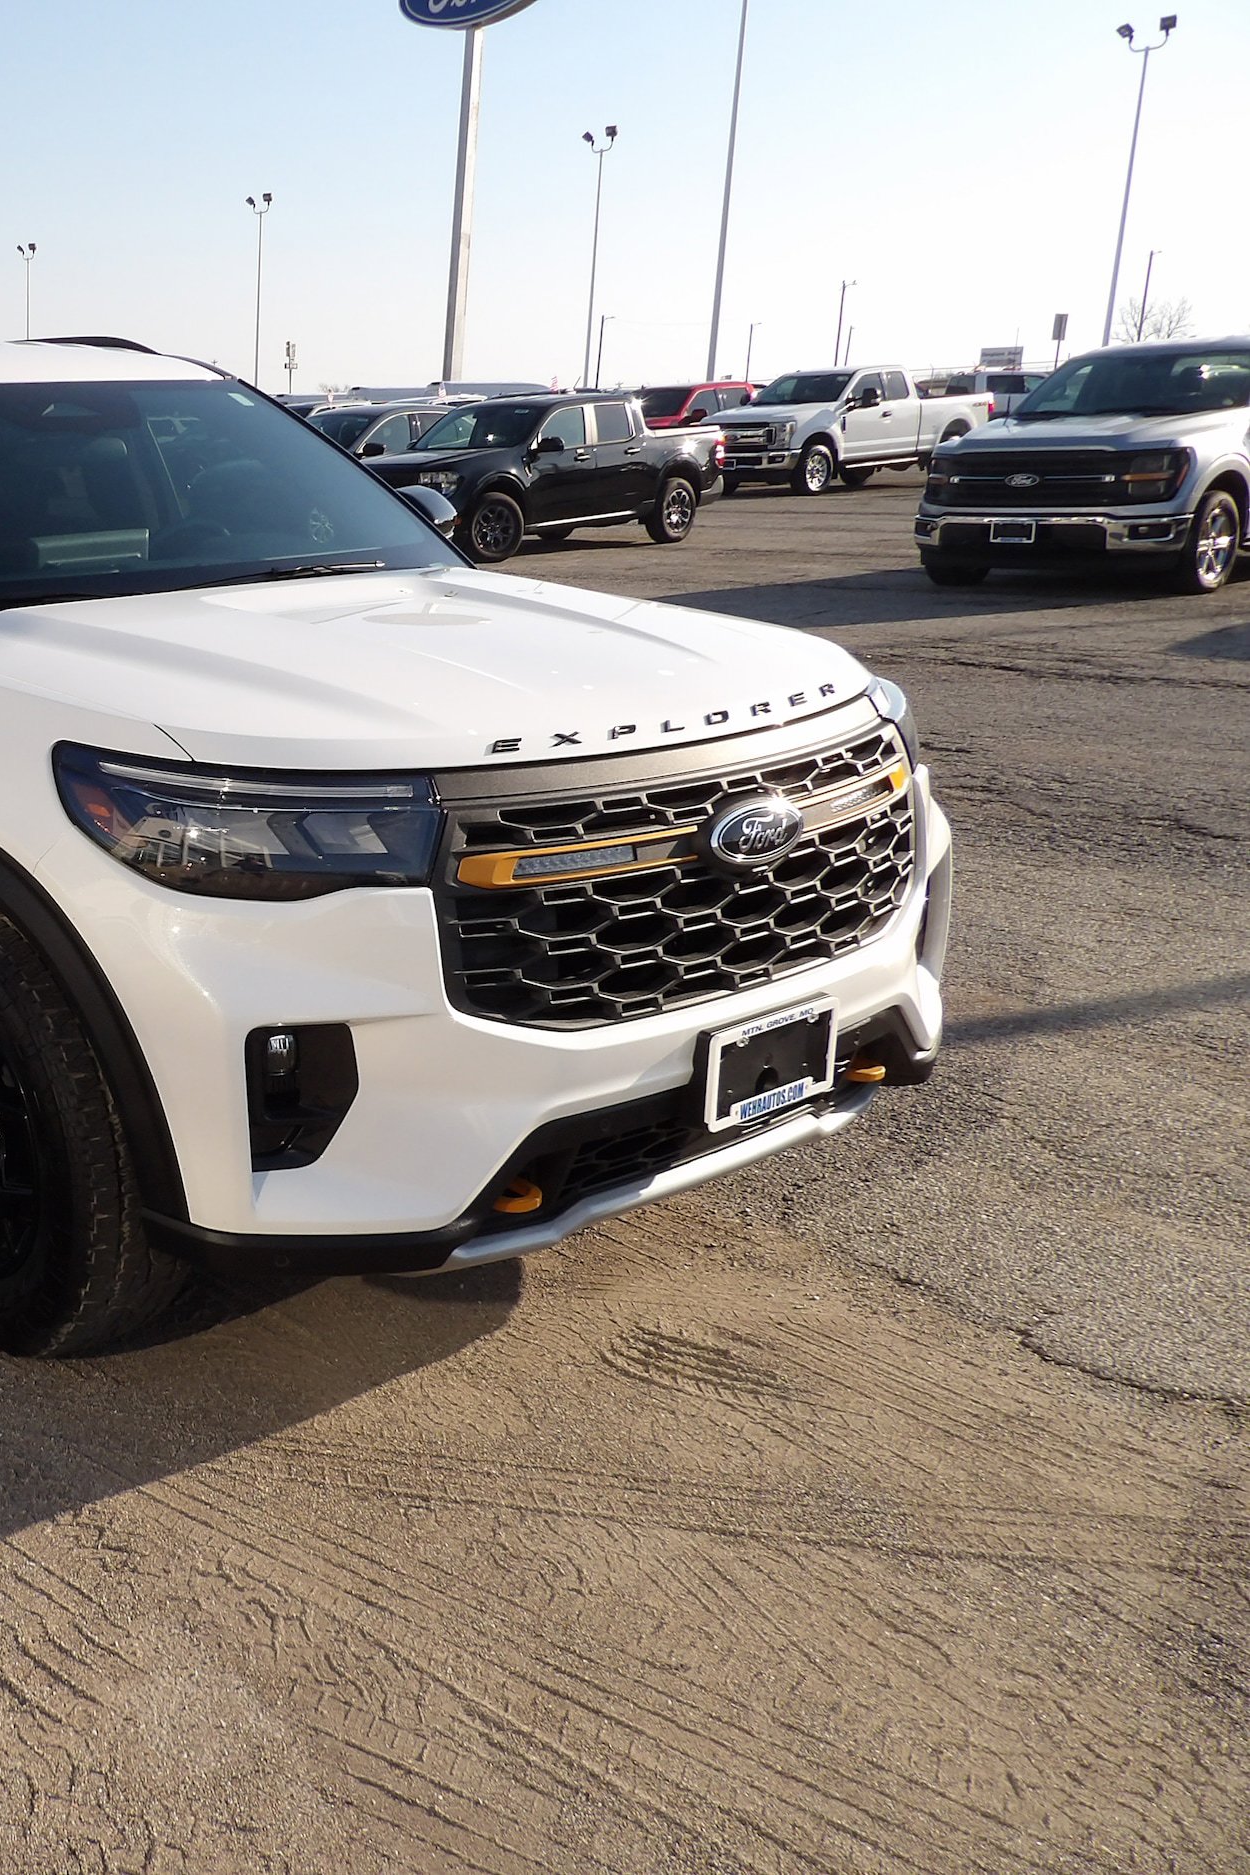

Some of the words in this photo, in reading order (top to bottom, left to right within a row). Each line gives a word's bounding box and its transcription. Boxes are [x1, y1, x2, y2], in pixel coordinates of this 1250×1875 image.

[490, 682, 837, 754] EXPLORER
[738, 814, 789, 852] Ford
[739, 1082, 805, 1121] WEHRAUTOS.COM
